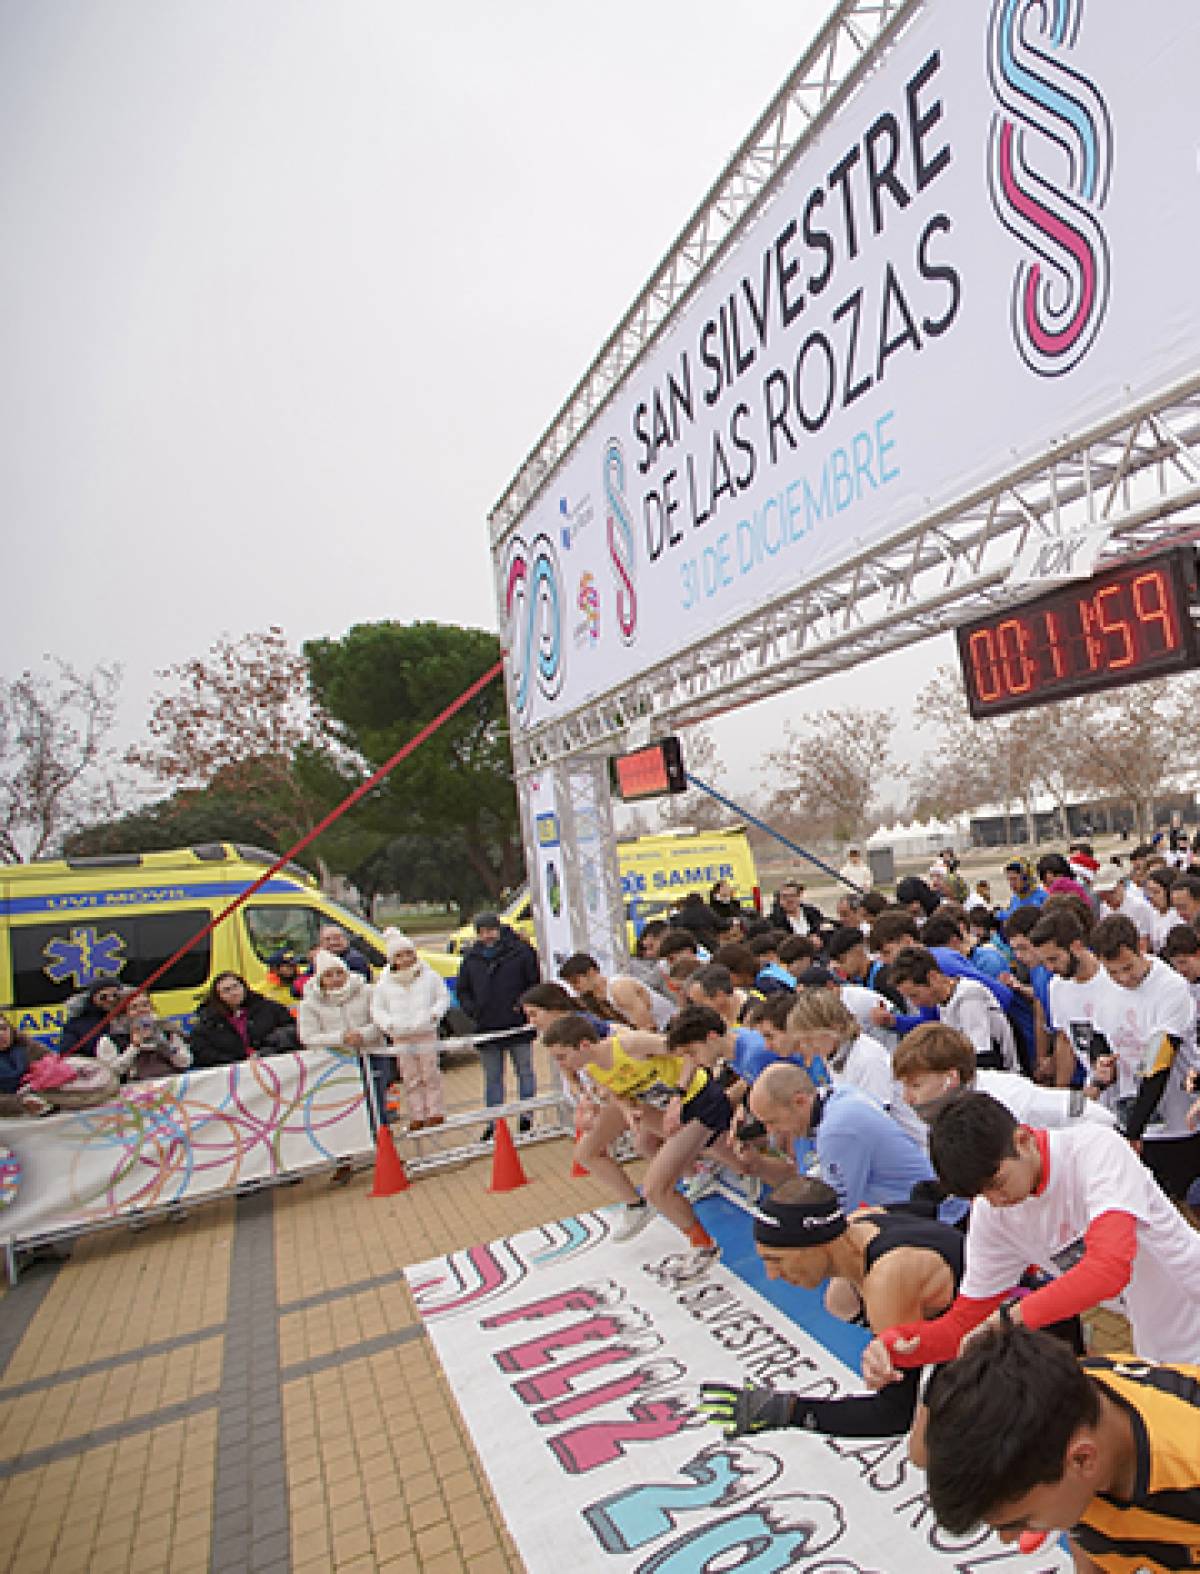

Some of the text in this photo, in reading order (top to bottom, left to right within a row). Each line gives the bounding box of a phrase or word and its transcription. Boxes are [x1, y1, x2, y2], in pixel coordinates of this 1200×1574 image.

[632, 49, 951, 474] SAN SILVESTRE
[643, 213, 962, 561] DE LAS ROZAS
[680, 410, 900, 609] 31 DE DICIEMBRE
[969, 571, 1176, 701] 00:11:59
[652, 863, 734, 890] SAMER
